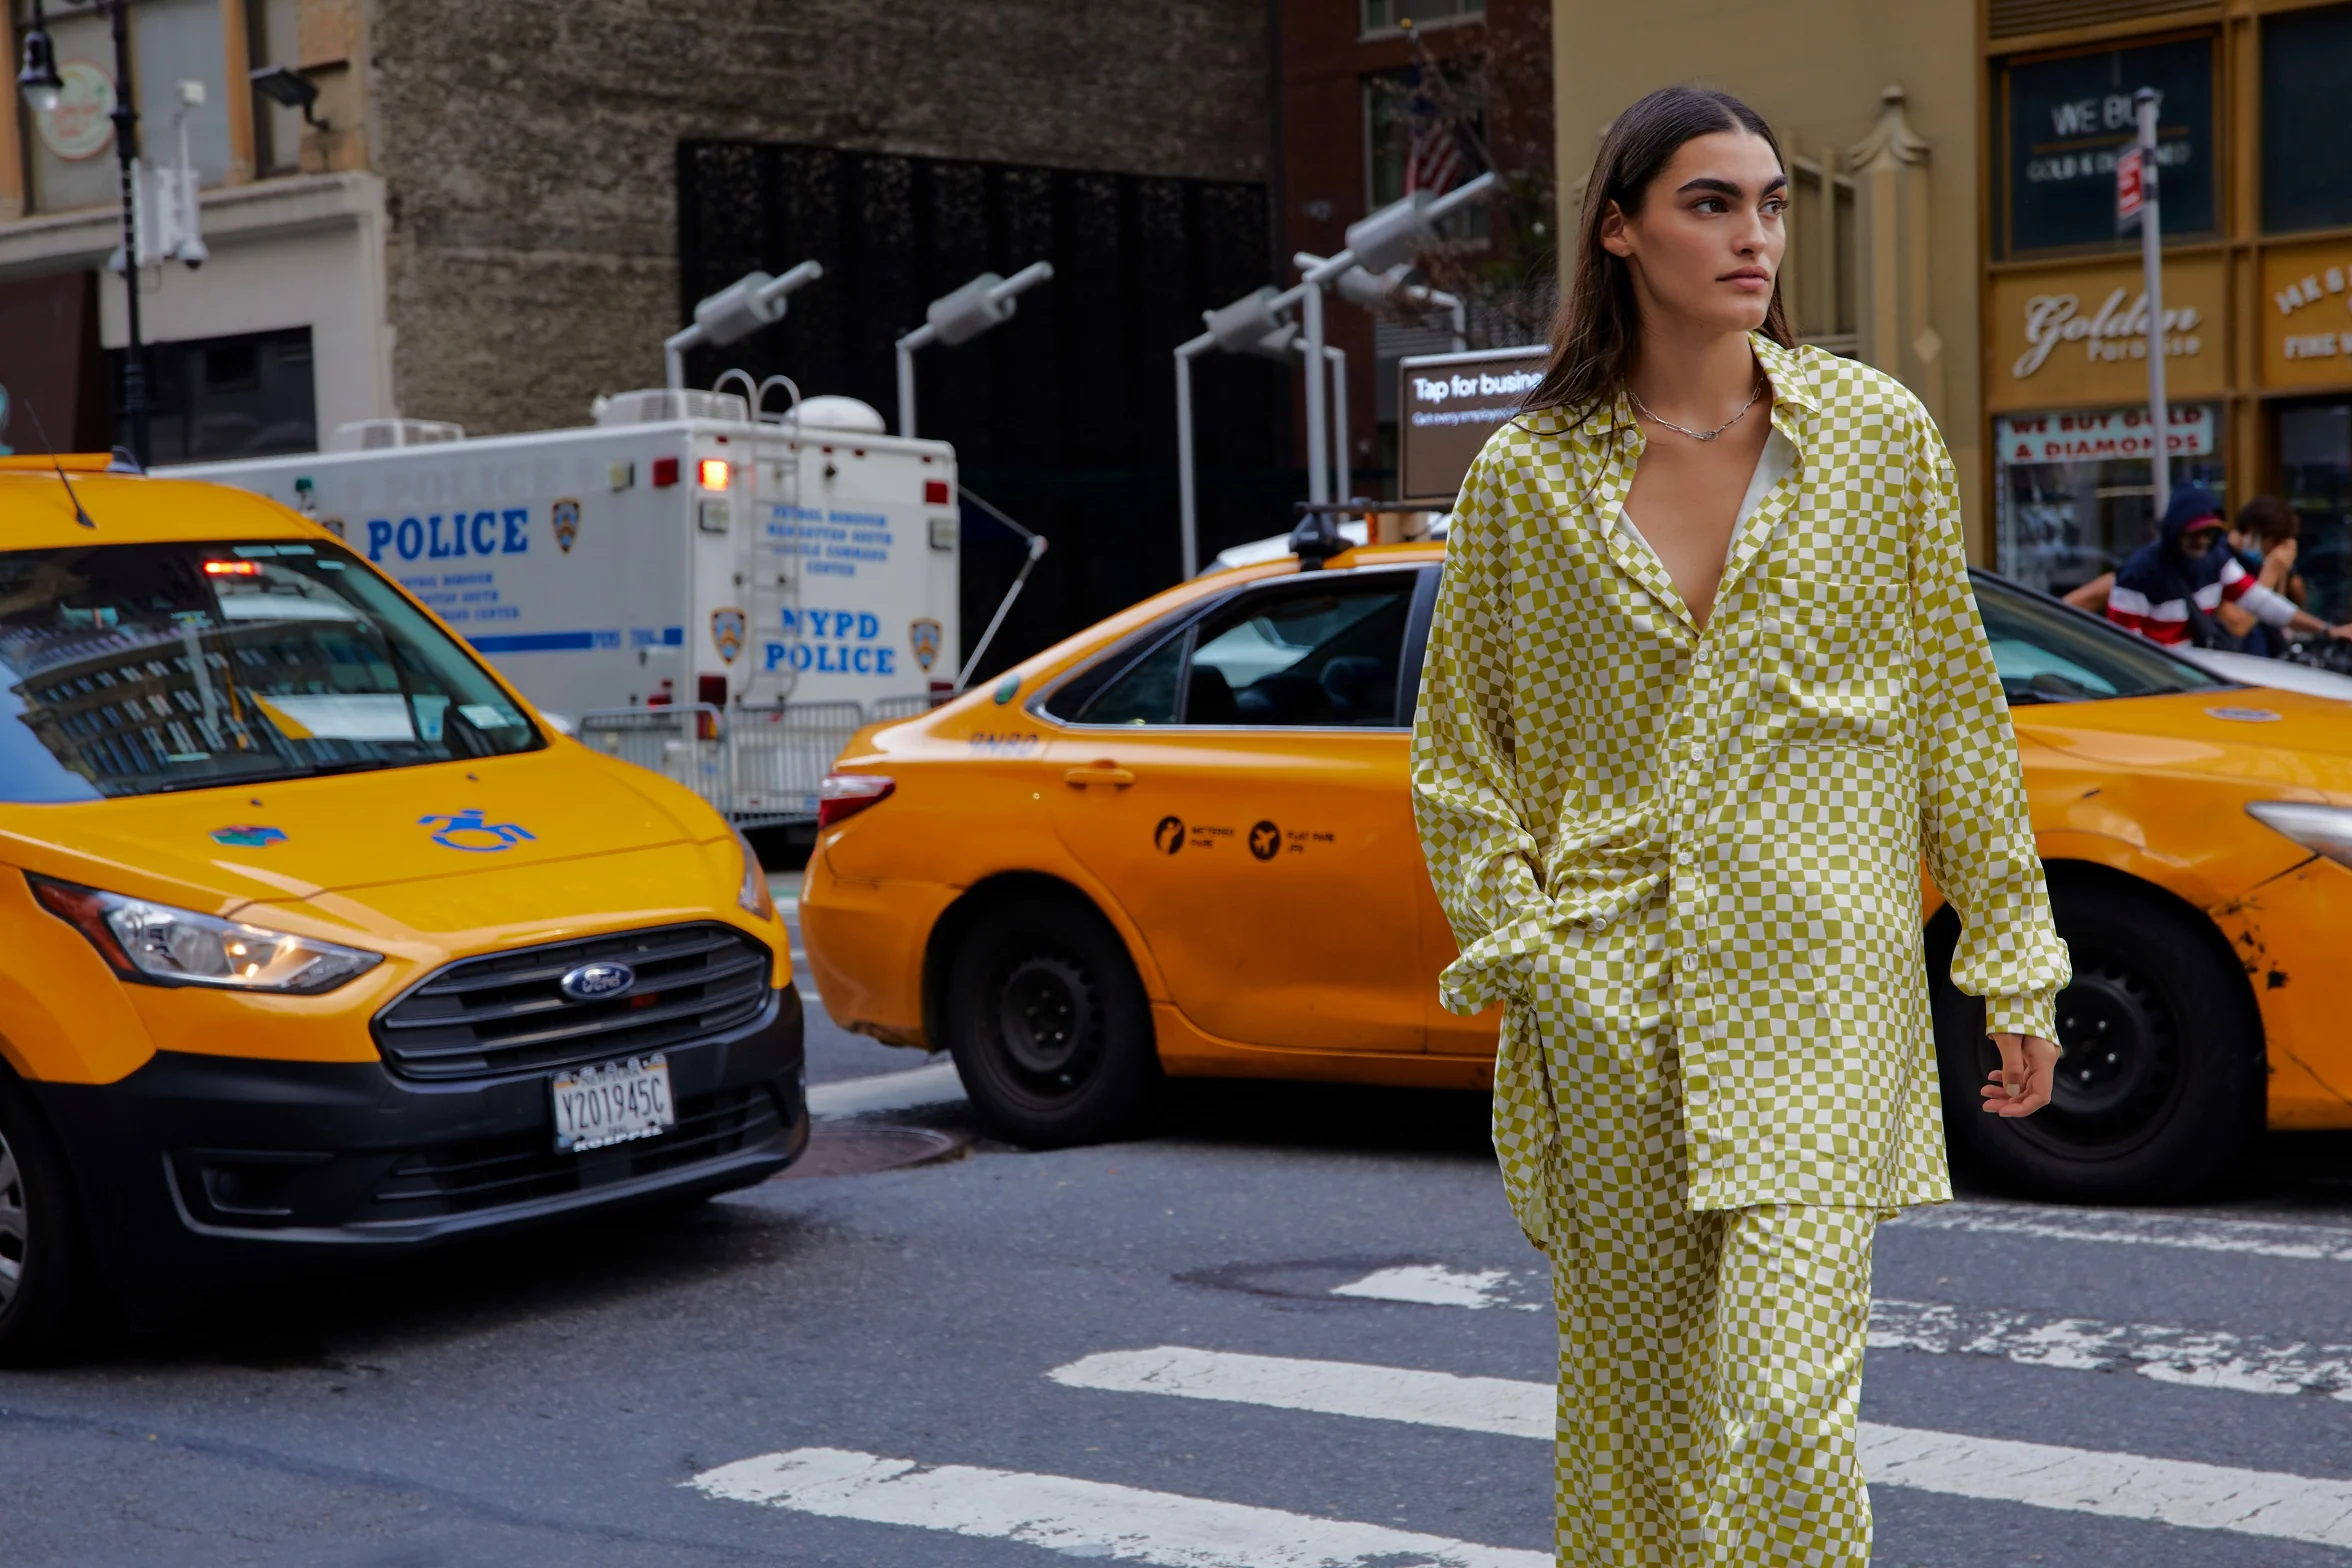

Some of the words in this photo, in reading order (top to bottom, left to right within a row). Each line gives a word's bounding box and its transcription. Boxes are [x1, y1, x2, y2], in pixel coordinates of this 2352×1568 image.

[2051, 99, 2098, 135] WE
[2026, 155, 2077, 182] GOLD
[2088, 336, 2200, 362] Paraise
[1412, 377, 1449, 404] Tap
[1450, 374, 1478, 398] for
[1480, 370, 1545, 396] busine
[2010, 417, 2048, 434] WE
[2060, 413, 2112, 431] BUY
[2015, 443, 2032, 460] &
[368, 509, 528, 562] POLICE
[782, 608, 880, 639] NYPD
[765, 642, 896, 675] POLICE
[582, 968, 620, 993] Ford
[562, 1077, 665, 1132] Y201945C
